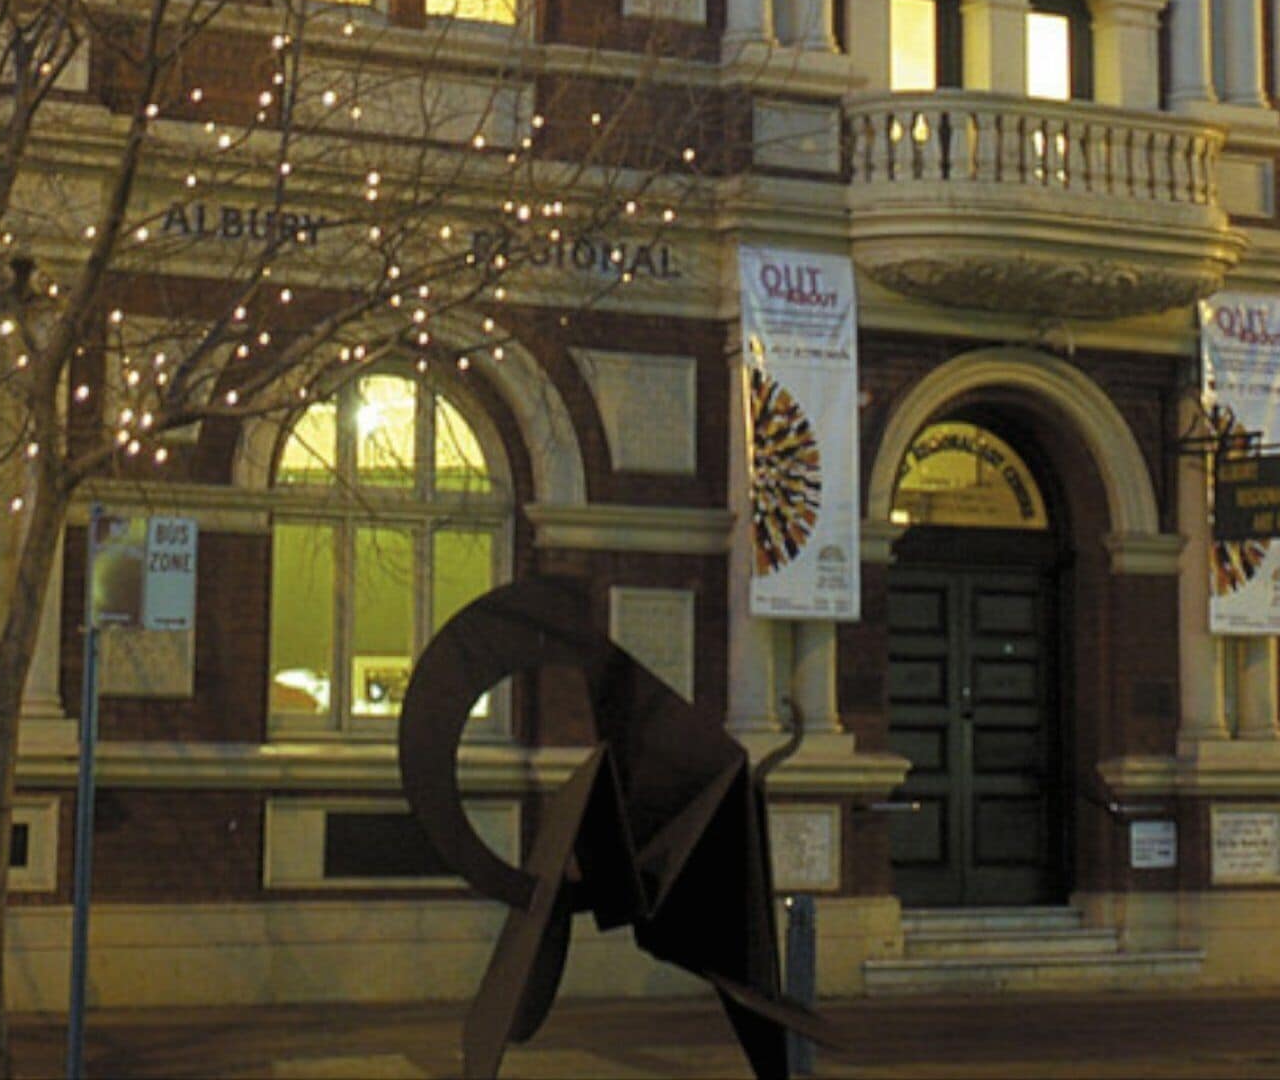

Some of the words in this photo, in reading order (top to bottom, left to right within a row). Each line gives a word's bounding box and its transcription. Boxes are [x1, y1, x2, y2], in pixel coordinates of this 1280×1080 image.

[761, 264, 823, 296] OUT
[156, 522, 189, 545] BUS
[150, 552, 193, 573] ZONE
